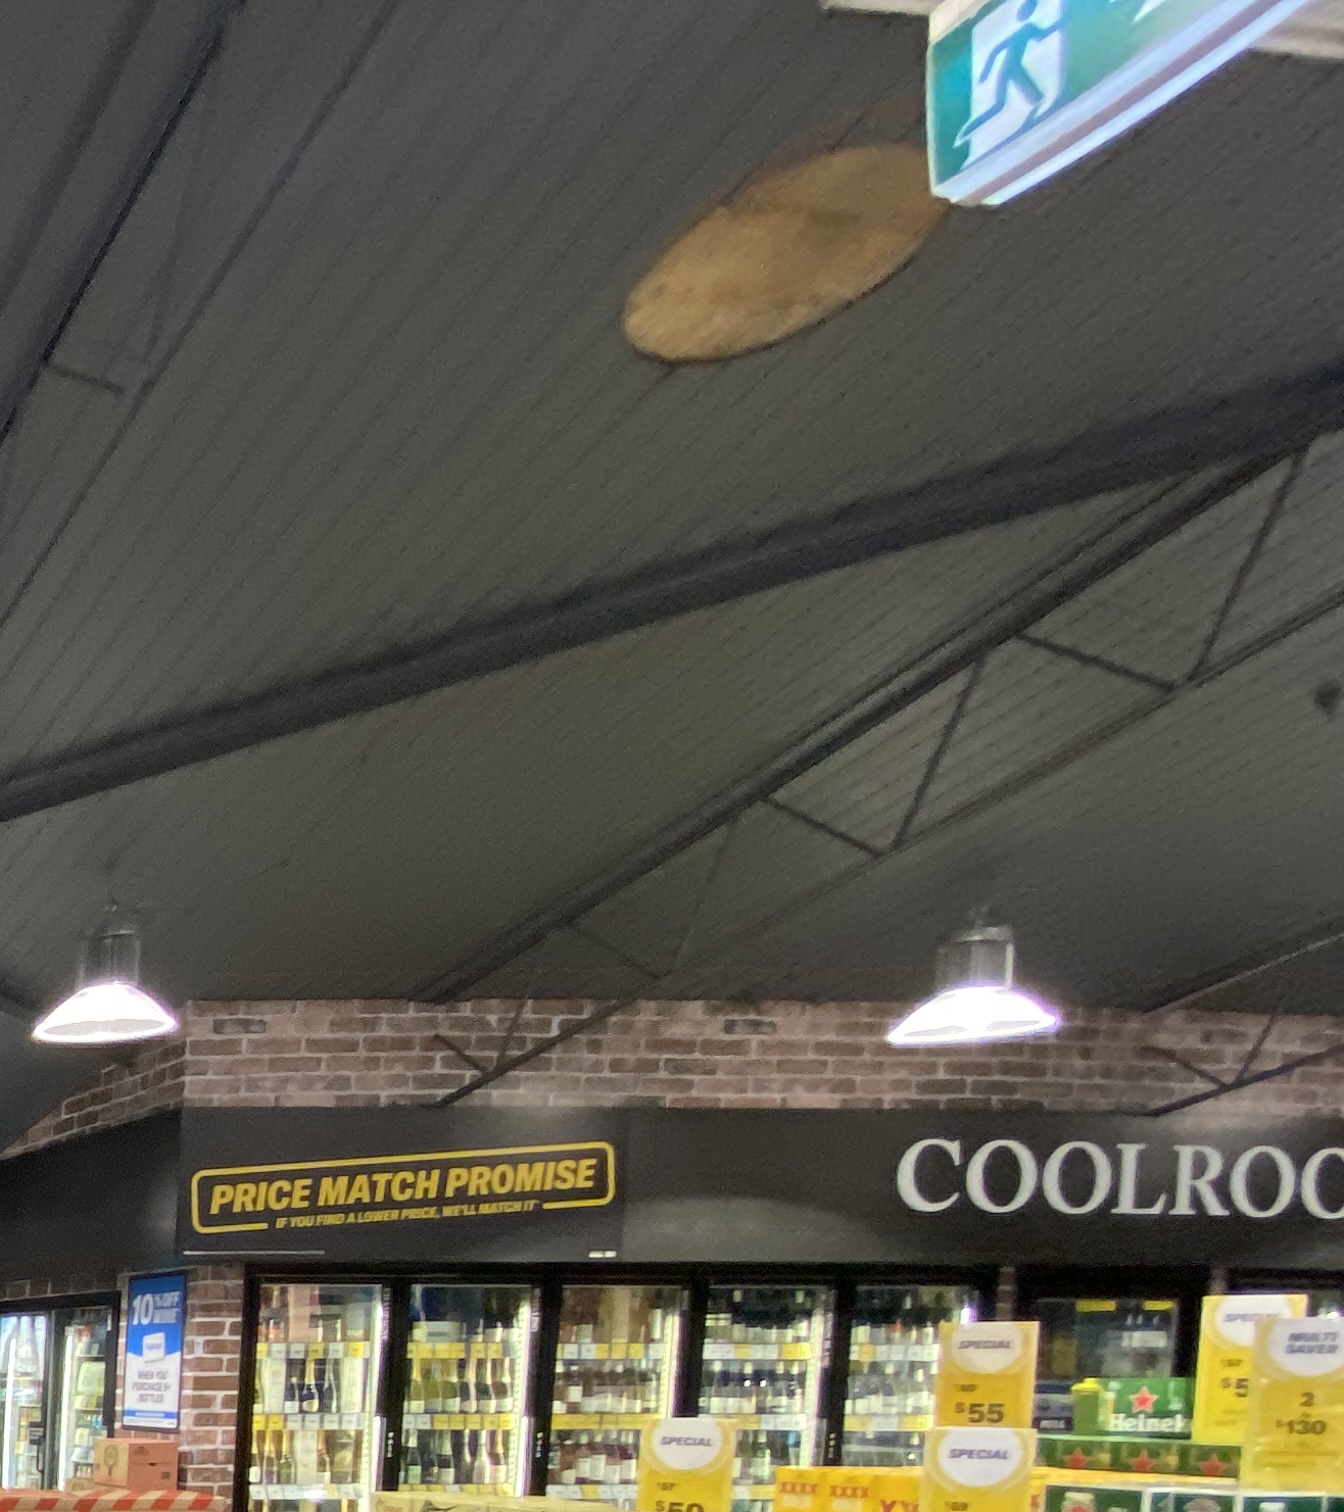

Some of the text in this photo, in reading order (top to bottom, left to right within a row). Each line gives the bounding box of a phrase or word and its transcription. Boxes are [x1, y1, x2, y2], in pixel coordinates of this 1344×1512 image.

[209, 1158, 598, 1215] PRICE MATCH PROMISE
[275, 1217, 287, 1229] IF
[289, 1214, 313, 1228] YOU
[315, 1212, 344, 1226] FIND
[346, 1211, 356, 1224] A
[357, 1208, 399, 1223] LOWER
[478, 1201, 520, 1216] MATCH
[132, 1293, 154, 1325] 10
[958, 1340, 1012, 1350] SPECIAL
[1288, 1331, 1339, 1343] MULTI
[1285, 1344, 1339, 1354] SAVER
[1300, 1391, 1316, 1407] 2
[955, 1402, 1005, 1424] $55
[1275, 1419, 1327, 1435] $130
[660, 1436, 713, 1447] SPECIAL
[948, 1449, 1009, 1460] SPECIAL
